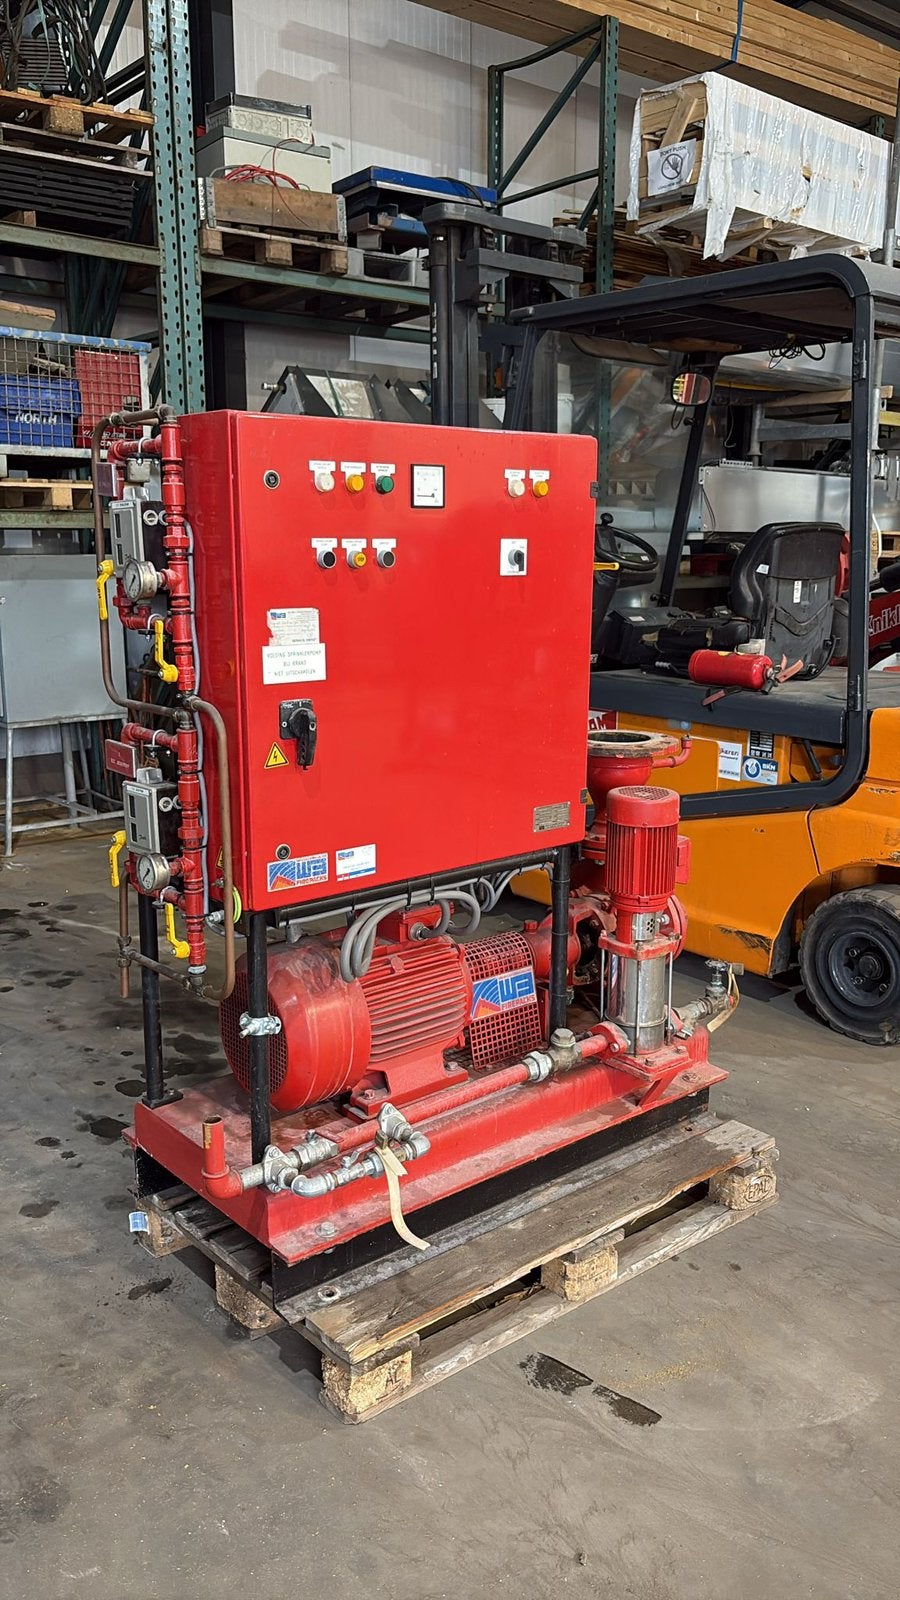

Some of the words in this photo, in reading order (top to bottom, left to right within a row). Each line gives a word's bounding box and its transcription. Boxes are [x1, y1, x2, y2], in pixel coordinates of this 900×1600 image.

[15, 412, 58, 426] NORTH
[297, 874, 327, 886] FIREPACKS
[502, 994, 537, 1011] FIREPACKS
